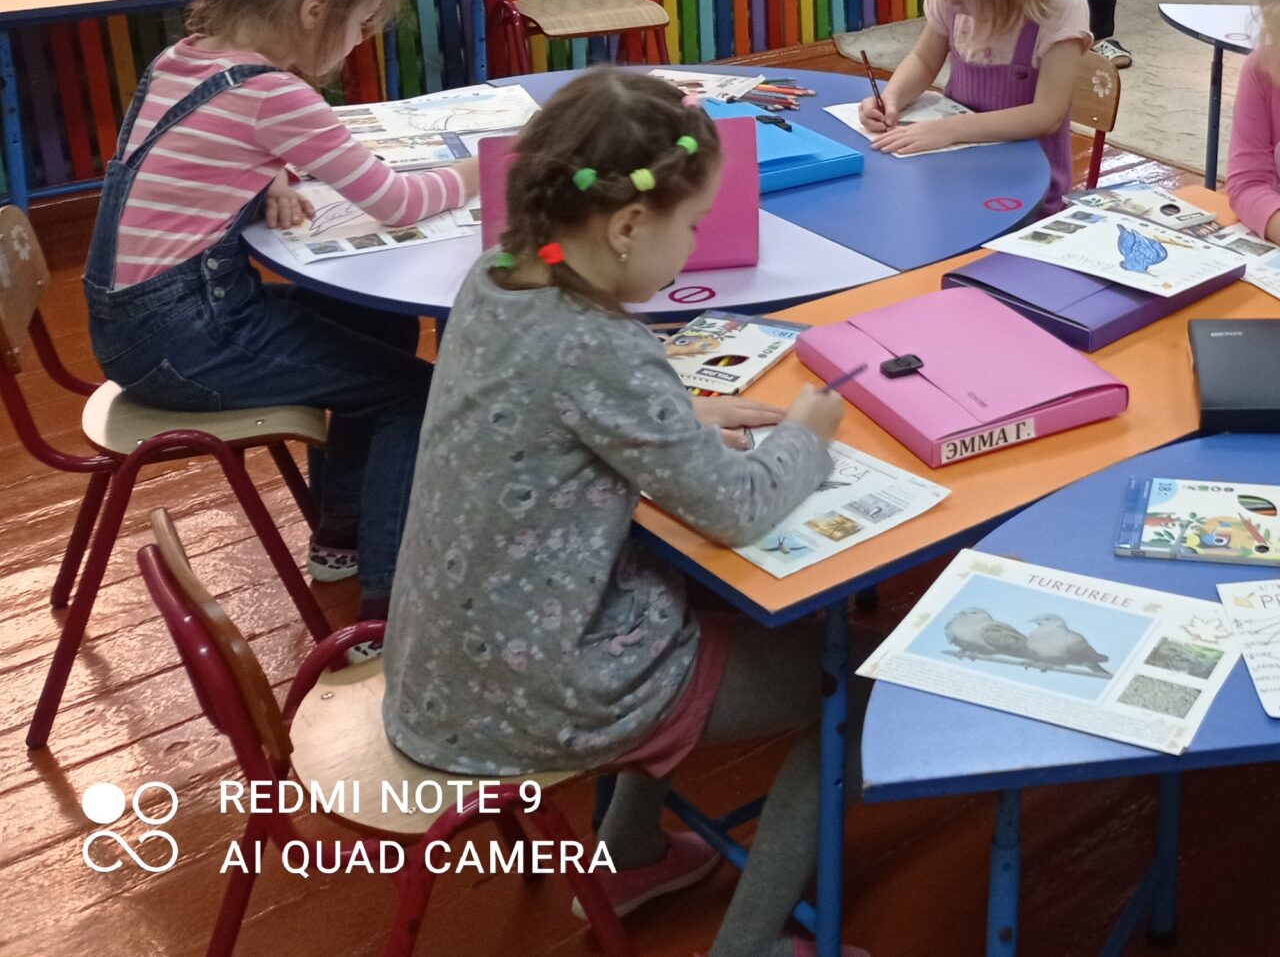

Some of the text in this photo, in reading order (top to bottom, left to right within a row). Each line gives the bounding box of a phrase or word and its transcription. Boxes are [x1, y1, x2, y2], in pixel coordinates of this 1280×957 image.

[702, 369, 734, 381] MILAN
[945, 421, 1031, 460] ЭММА Г.
[1026, 573, 1135, 609] TURTURELE
